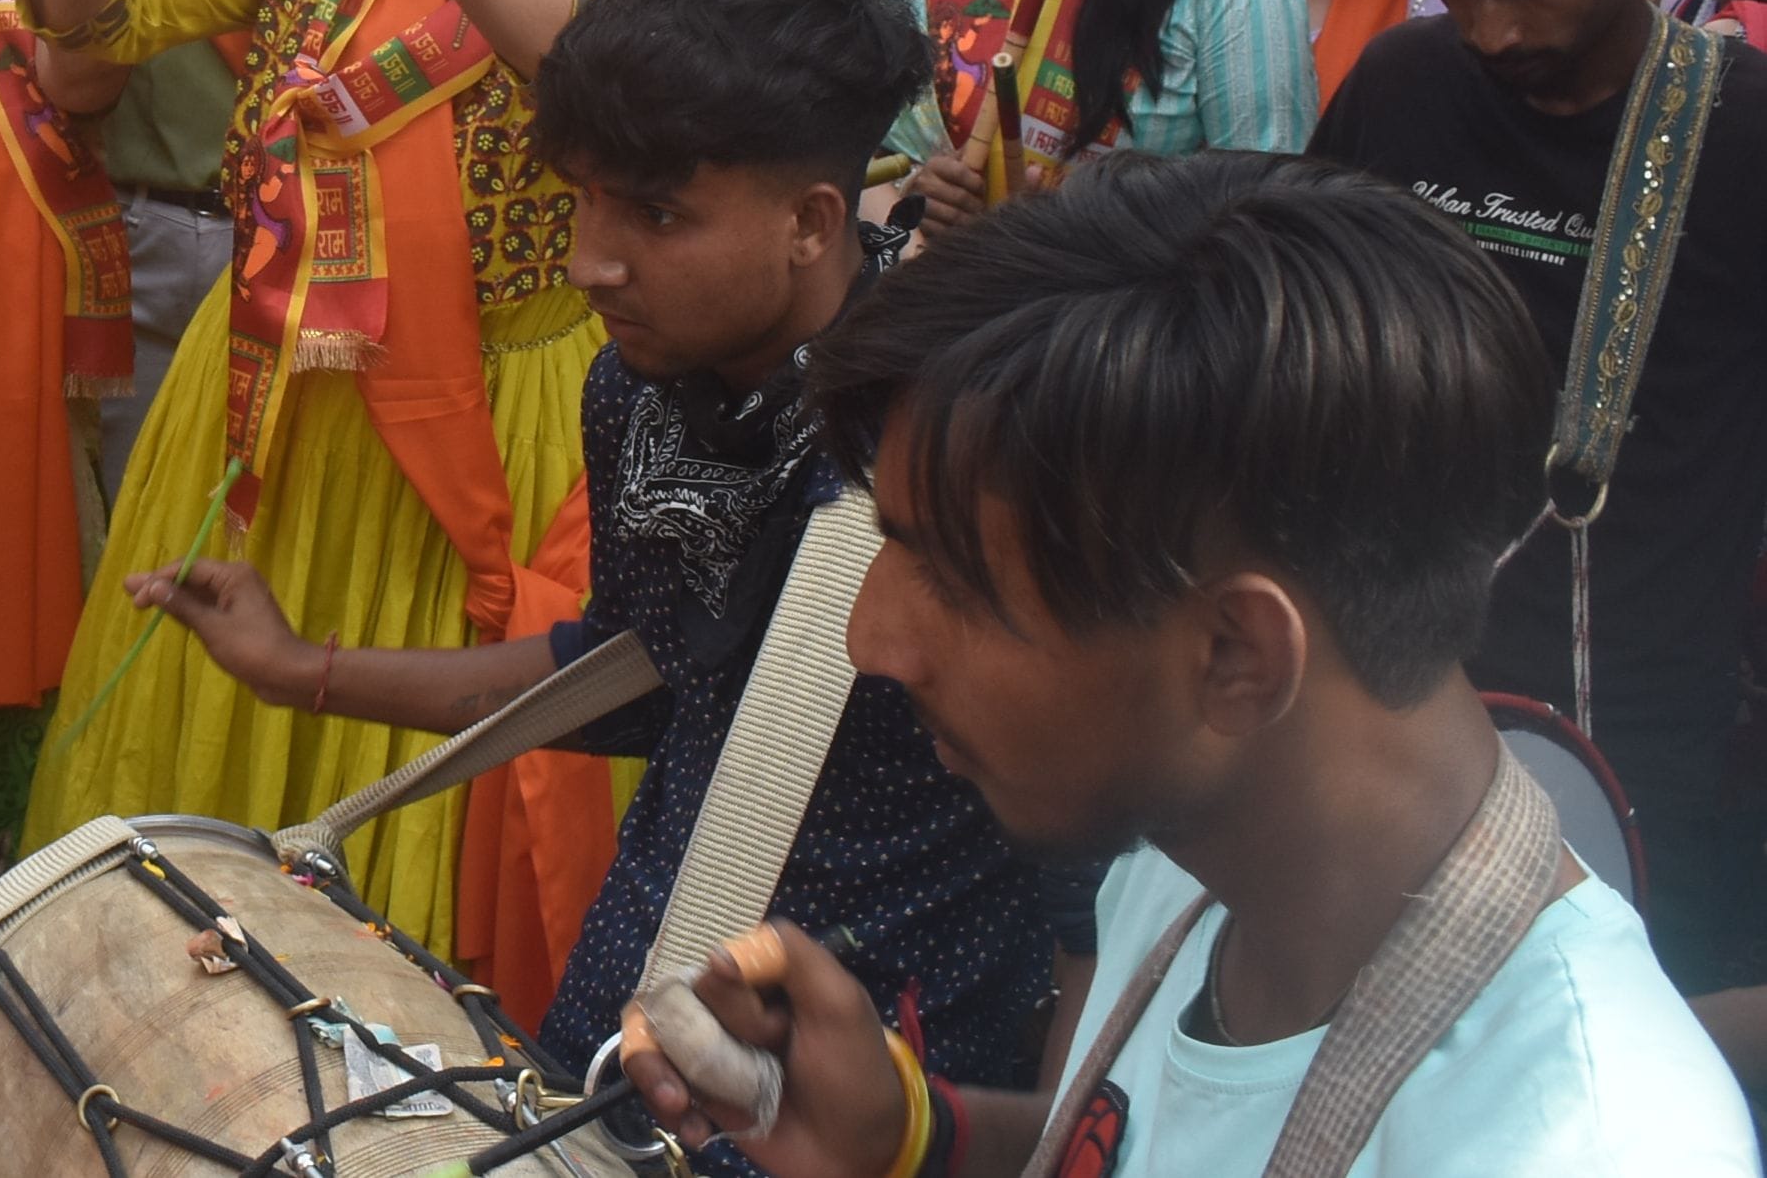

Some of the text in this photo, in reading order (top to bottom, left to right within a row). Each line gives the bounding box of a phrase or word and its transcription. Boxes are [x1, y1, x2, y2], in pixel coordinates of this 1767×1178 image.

[302, 28, 324, 54] जय
[316, 187, 345, 216] राम
[1475, 191, 1564, 233] Trusted
[318, 229, 346, 258] राम
[1500, 244, 1521, 258] LESS
